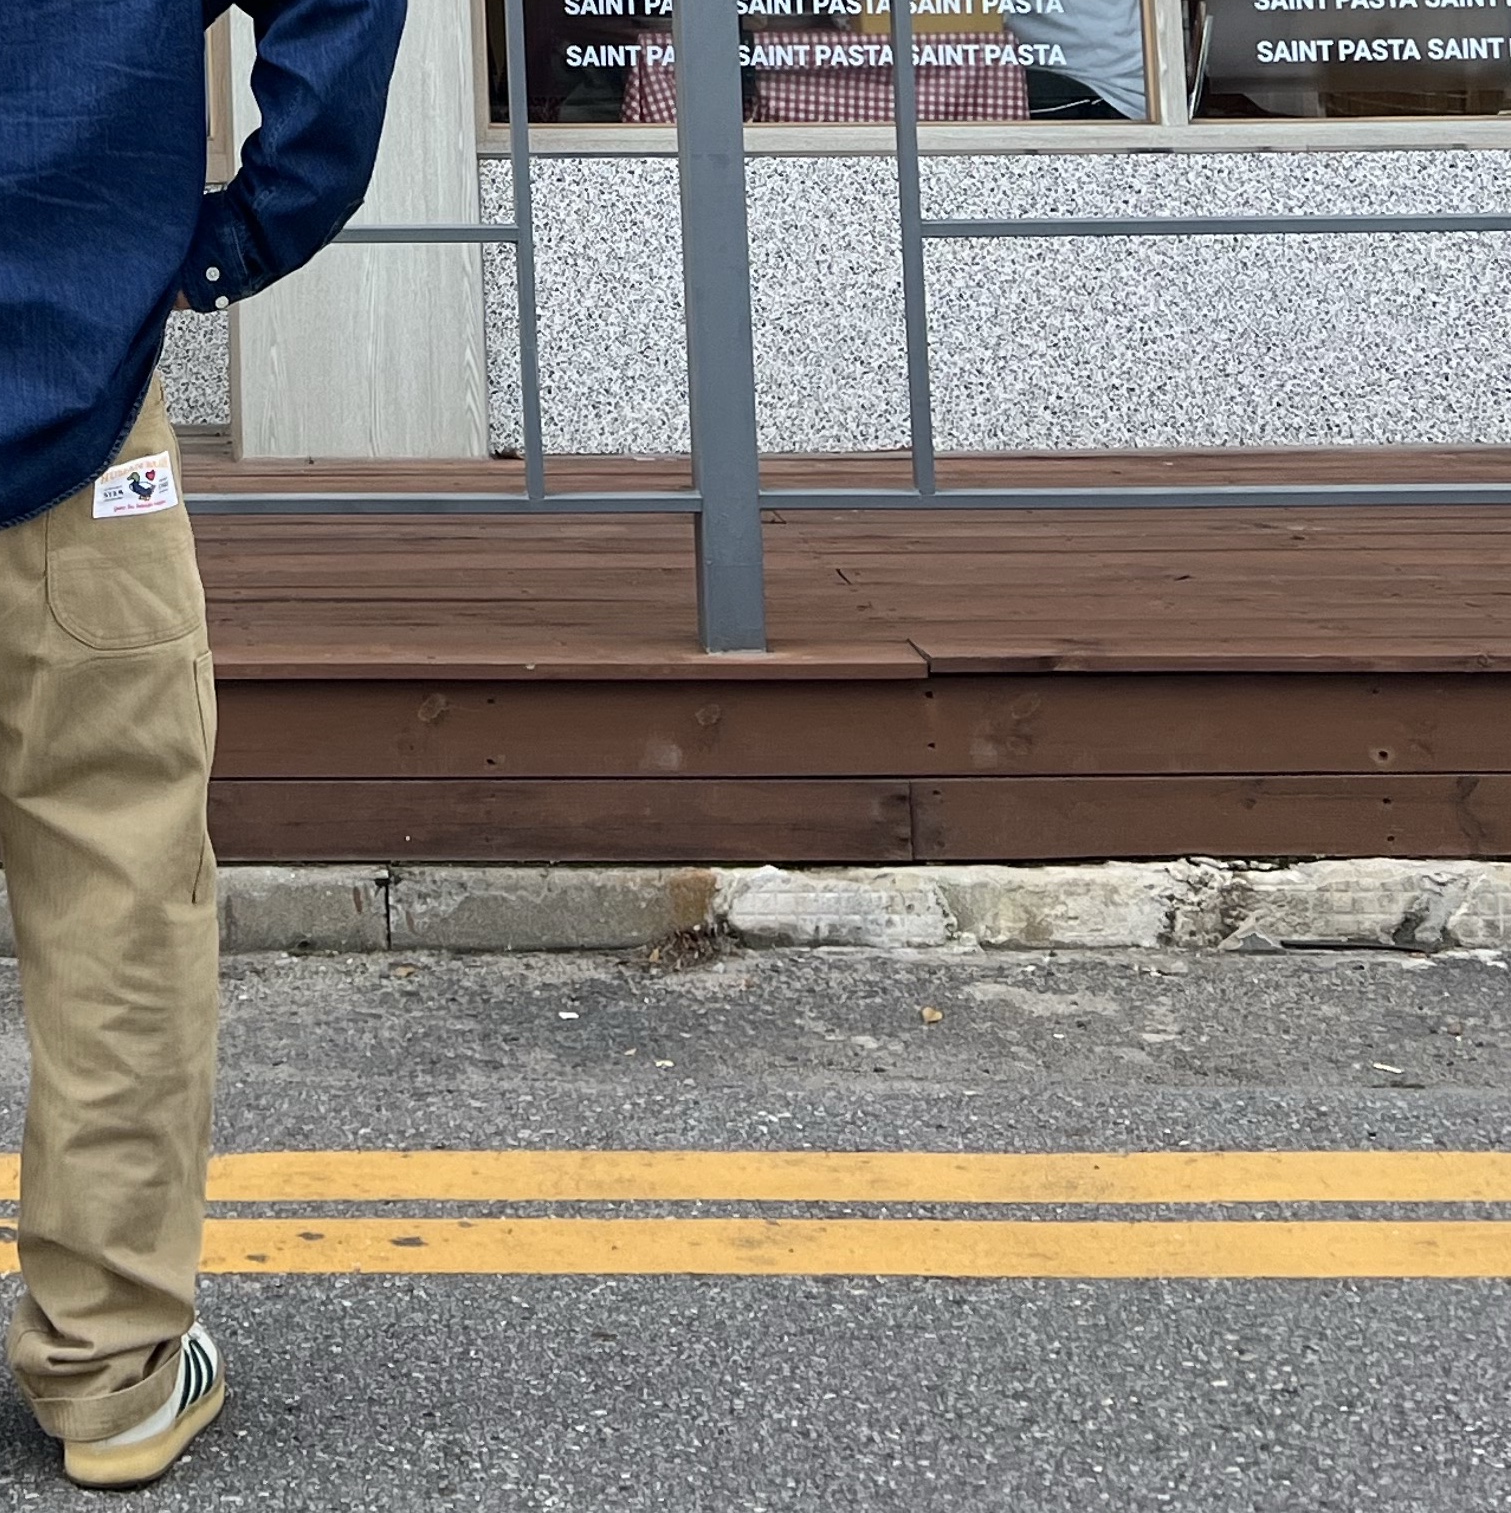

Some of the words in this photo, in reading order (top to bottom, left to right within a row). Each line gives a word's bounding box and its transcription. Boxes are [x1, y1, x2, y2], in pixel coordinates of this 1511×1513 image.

[566, 45, 641, 67] SAINT
[738, 44, 810, 67] SAINT
[815, 44, 893, 67] PASTA
[985, 44, 1067, 66] PASTA
[1257, 40, 1334, 63] SAINT
[1339, 39, 1421, 62] PASTA
[1428, 38, 1503, 61] SAINT
